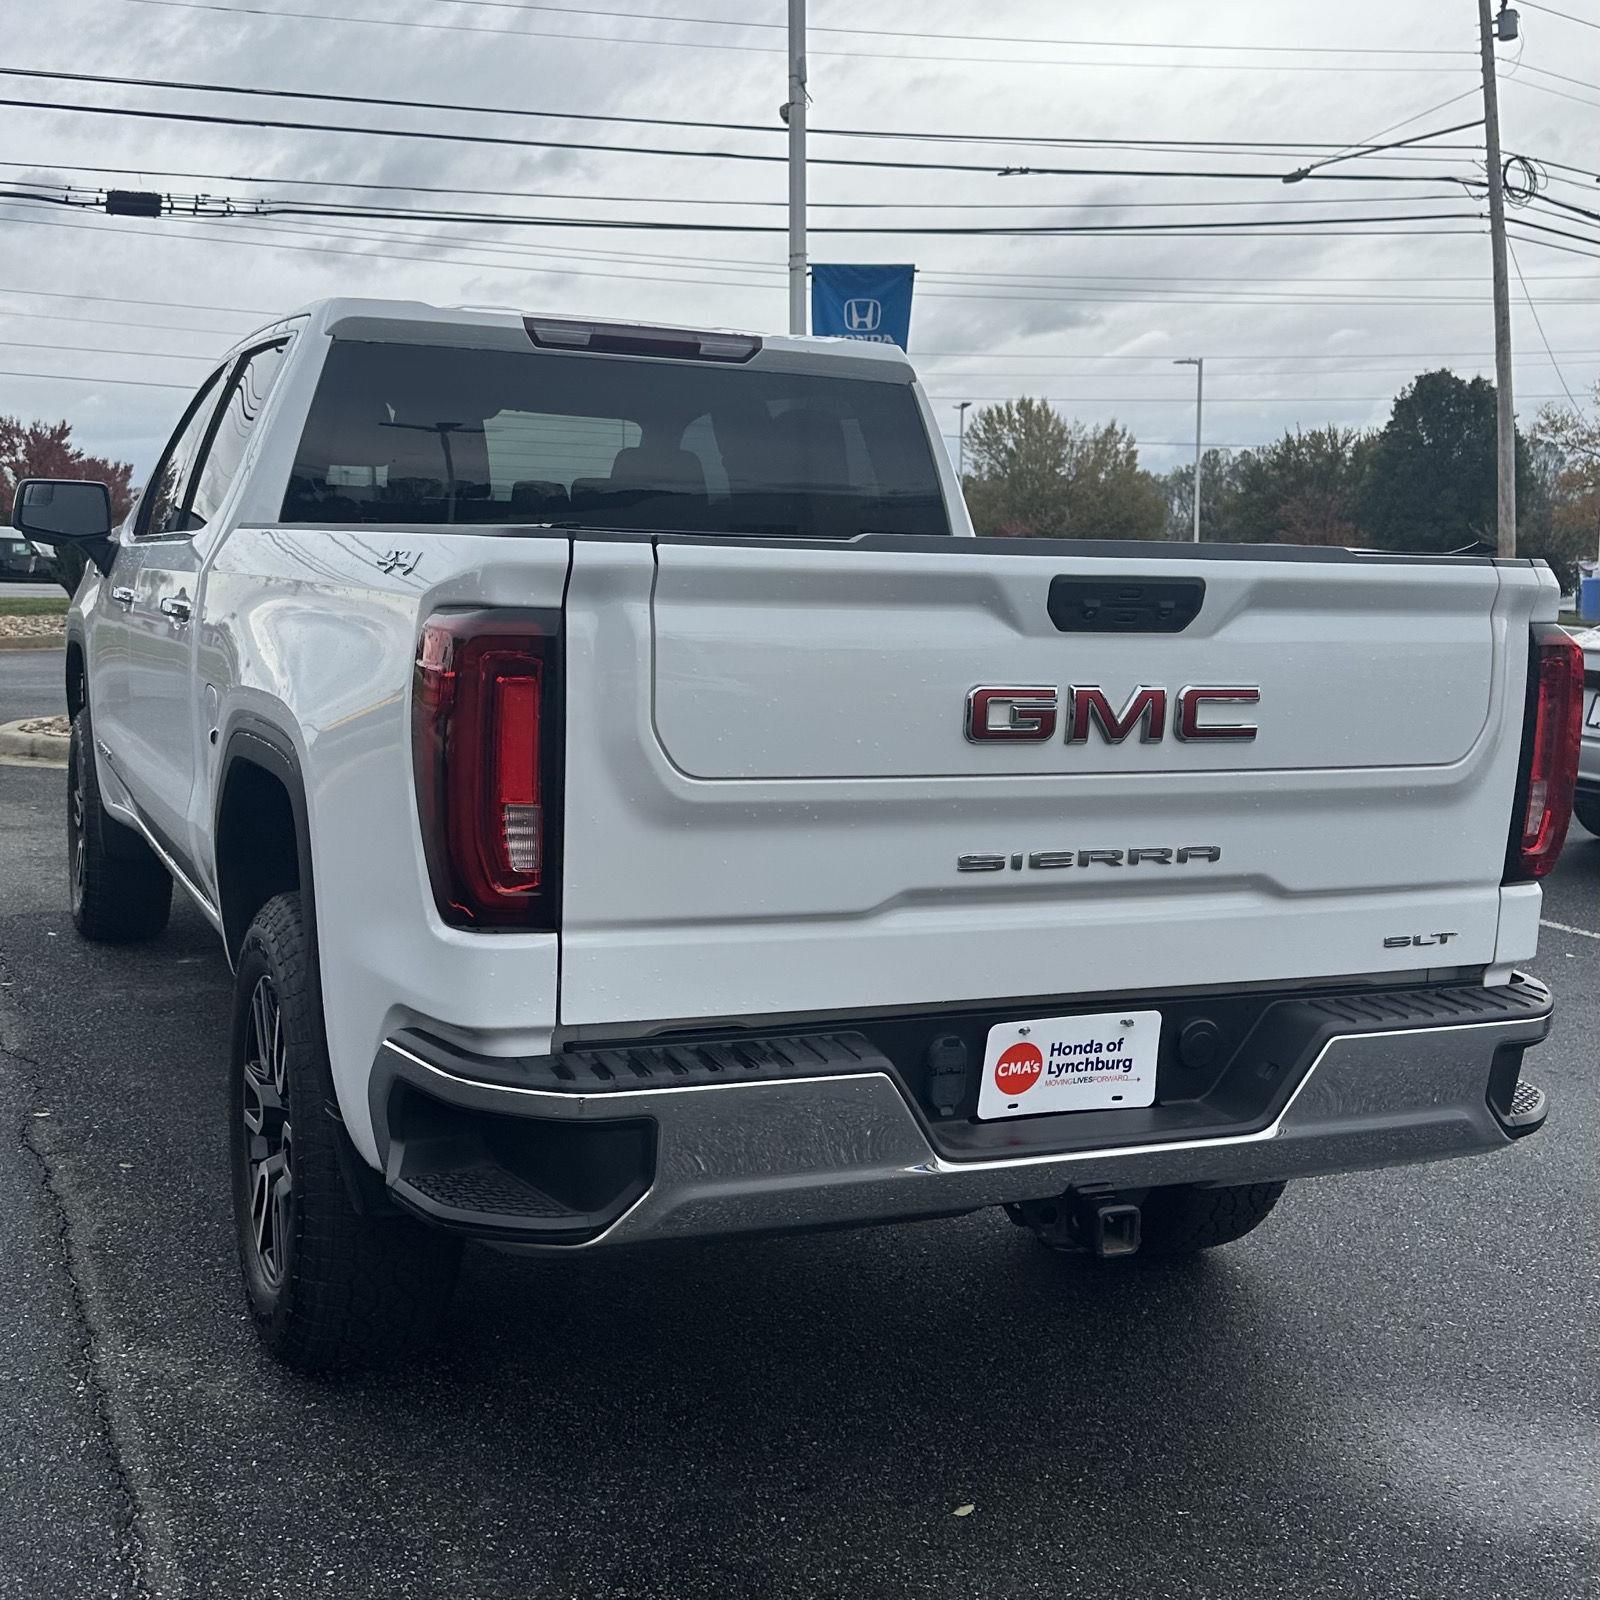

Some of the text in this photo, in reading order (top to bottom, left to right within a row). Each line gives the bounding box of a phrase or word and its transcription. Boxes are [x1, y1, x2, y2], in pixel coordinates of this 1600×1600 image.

[831, 334, 895, 344] ONDA
[963, 684, 1260, 745] GMC
[957, 845, 1222, 873] SIERRA
[1383, 932, 1459, 948] SLT
[1050, 1037, 1125, 1057] Honda of
[998, 1059, 1040, 1077] CMA's
[1047, 1057, 1133, 1079] Lynchburg
